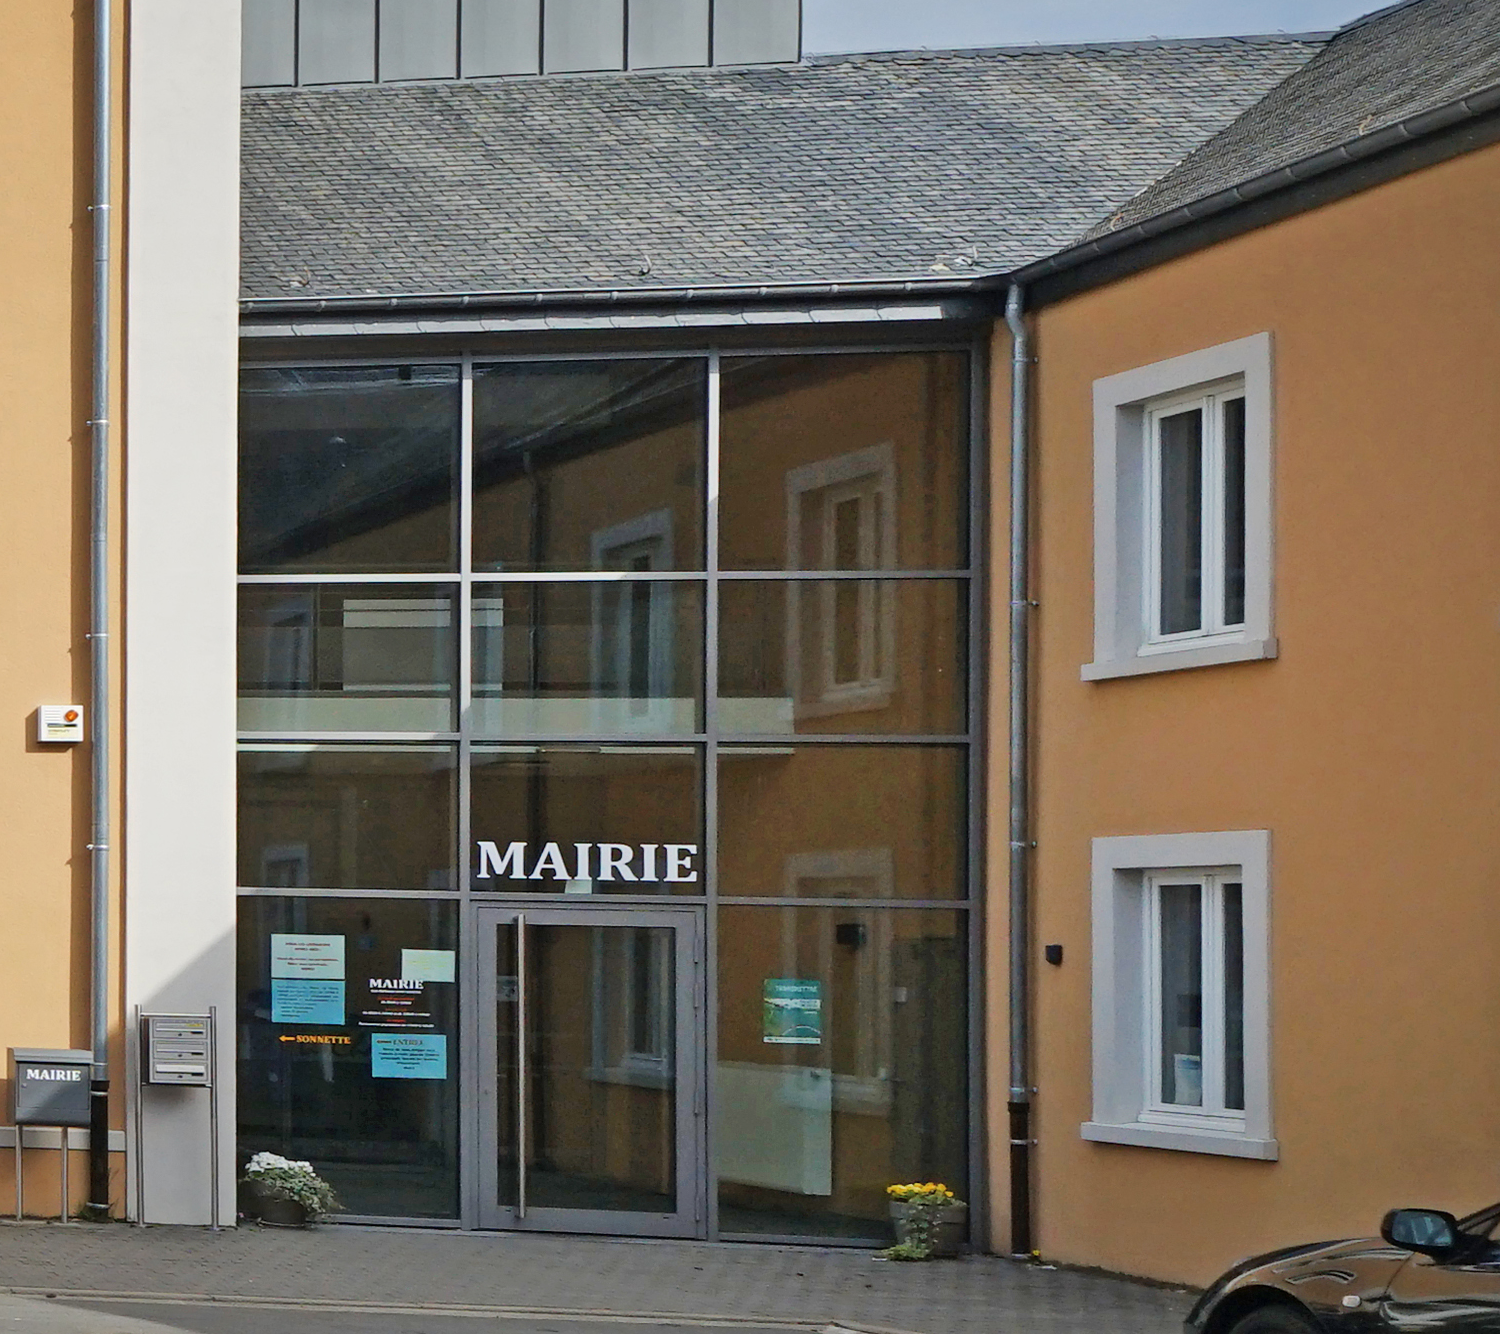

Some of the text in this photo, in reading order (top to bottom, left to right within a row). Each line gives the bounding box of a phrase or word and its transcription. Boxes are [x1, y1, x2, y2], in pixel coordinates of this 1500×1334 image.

[476, 841, 698, 882] MAIRIE
[369, 978, 424, 989] MAIRIE
[296, 1034, 351, 1044] SONNETTE
[26, 1069, 82, 1081] MAIRIE
